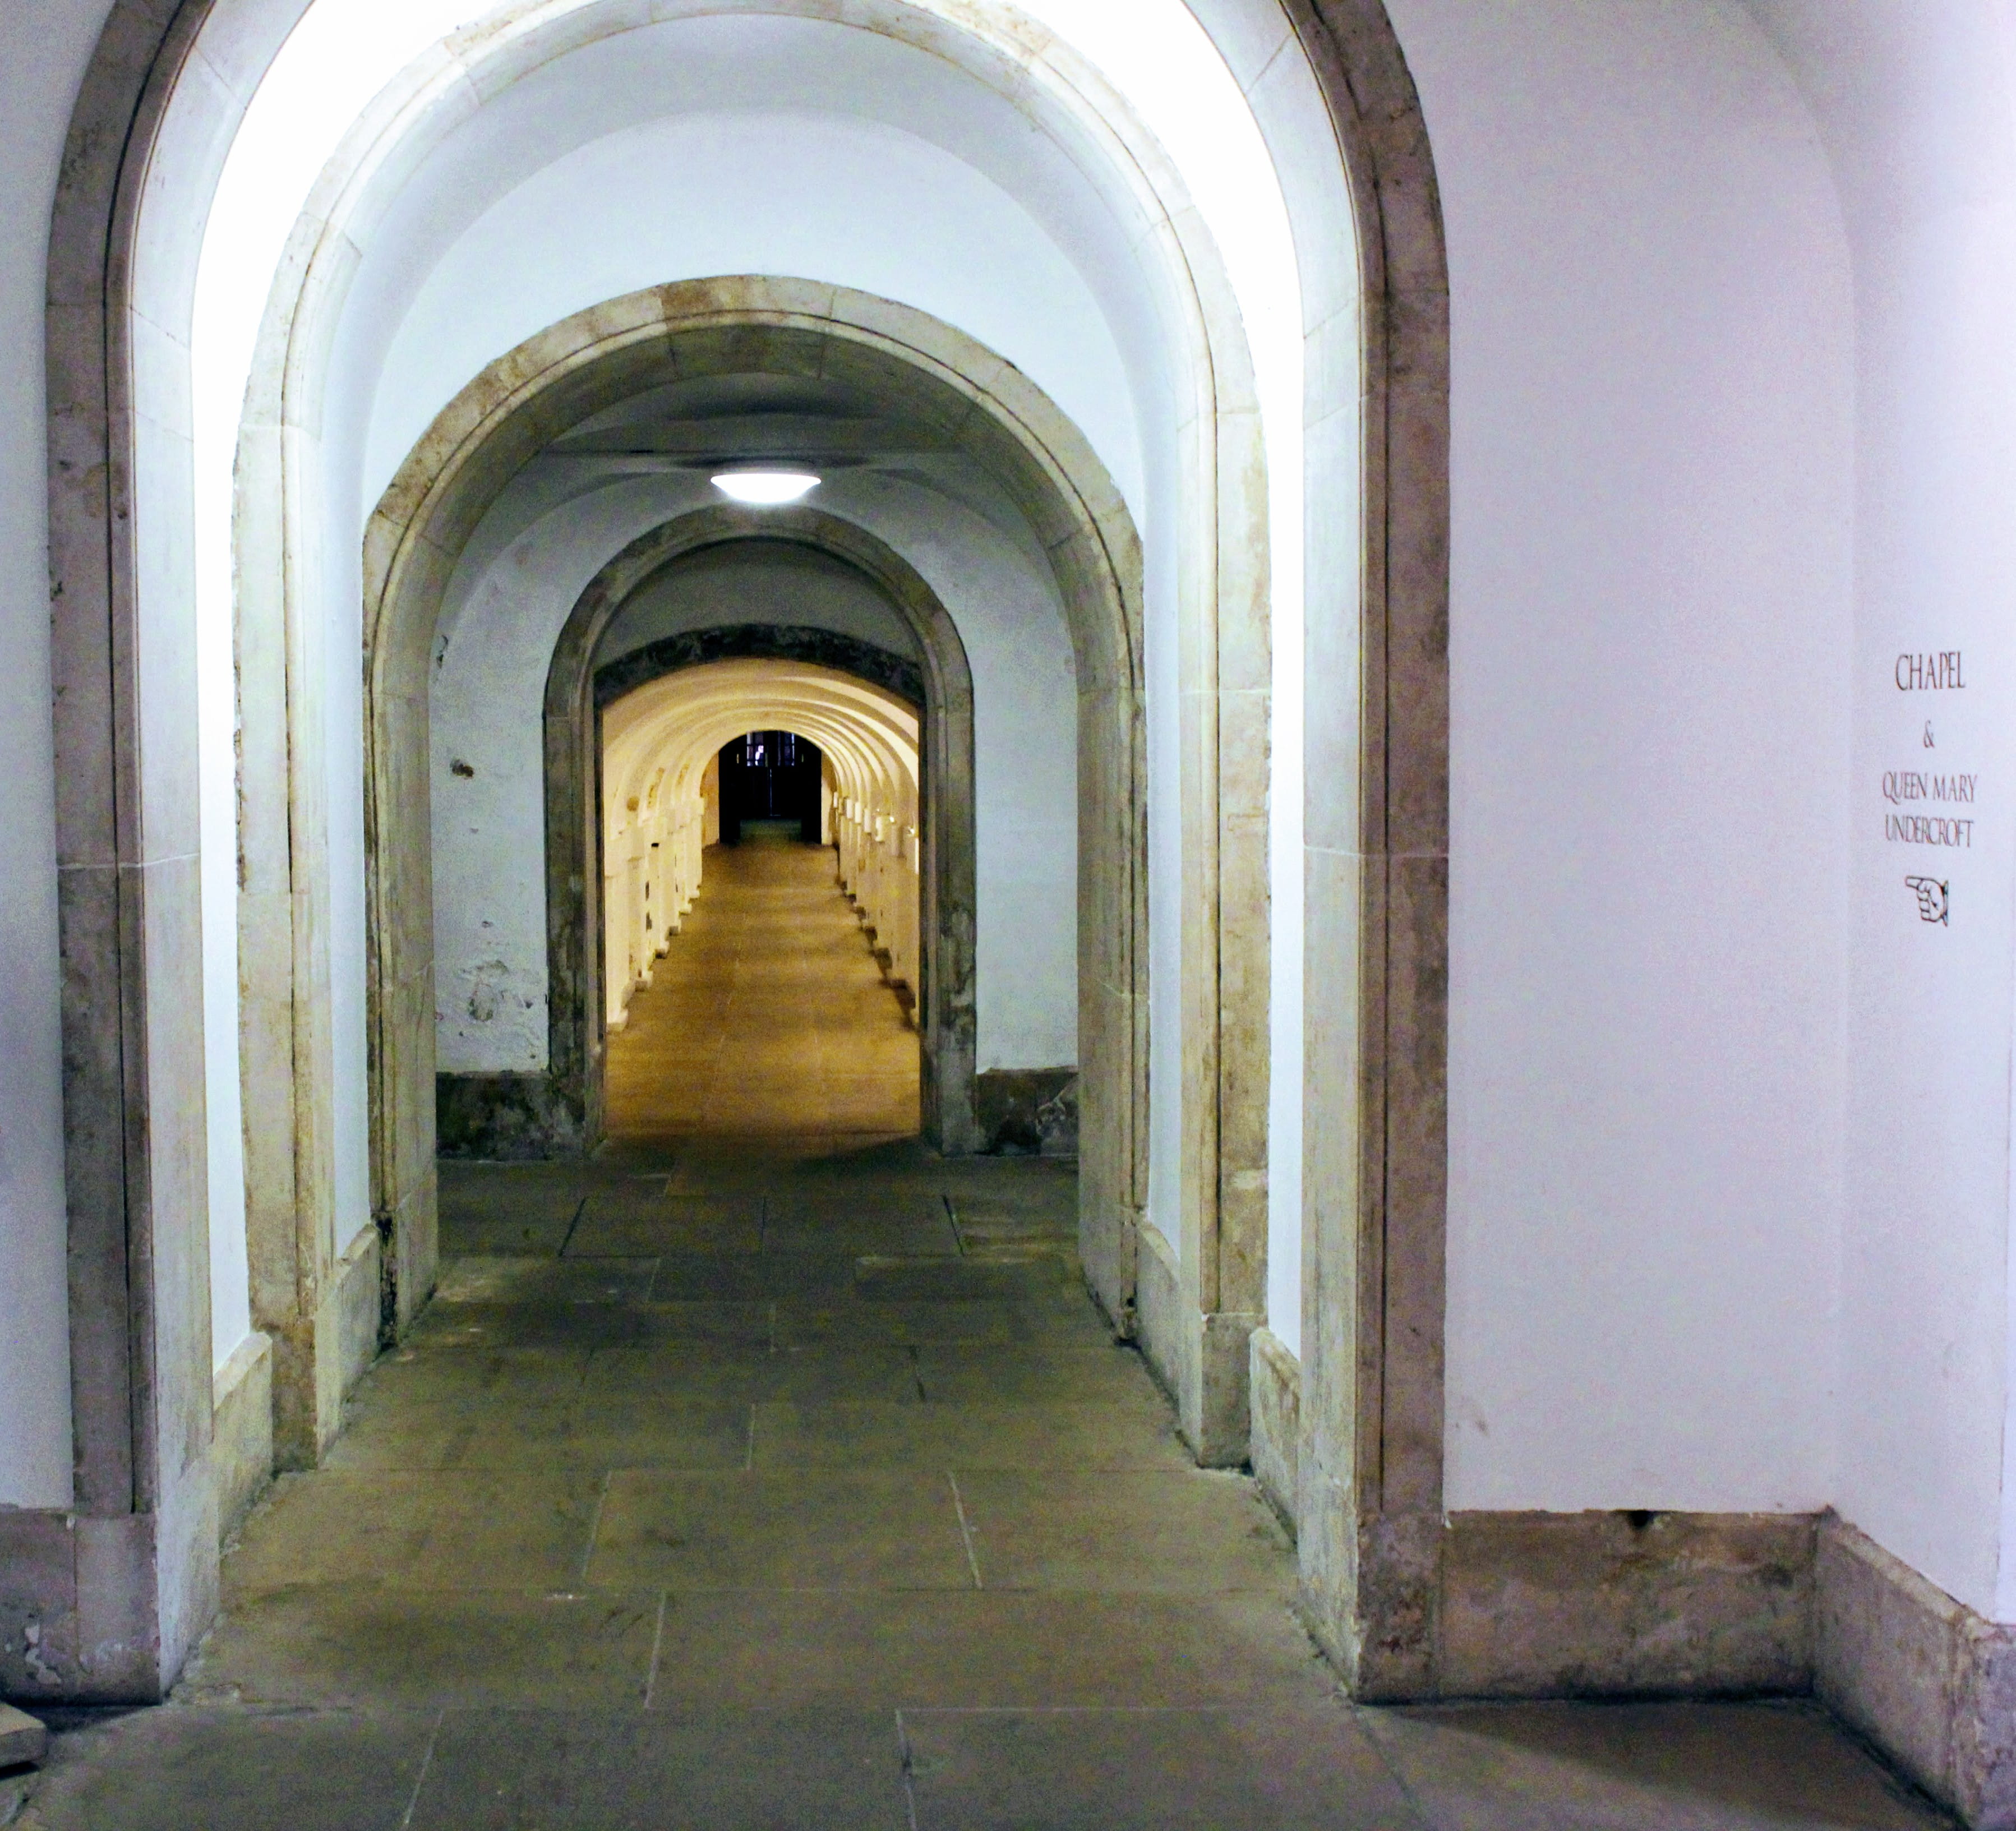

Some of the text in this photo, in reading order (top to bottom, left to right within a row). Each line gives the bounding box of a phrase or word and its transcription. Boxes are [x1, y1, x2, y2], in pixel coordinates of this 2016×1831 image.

[1895, 651, 1966, 691] CHAPEL
[1923, 720, 1935, 748] &
[1883, 771, 1978, 805] QUEEN MARY
[1885, 814, 1974, 847] UNDERCROFT
